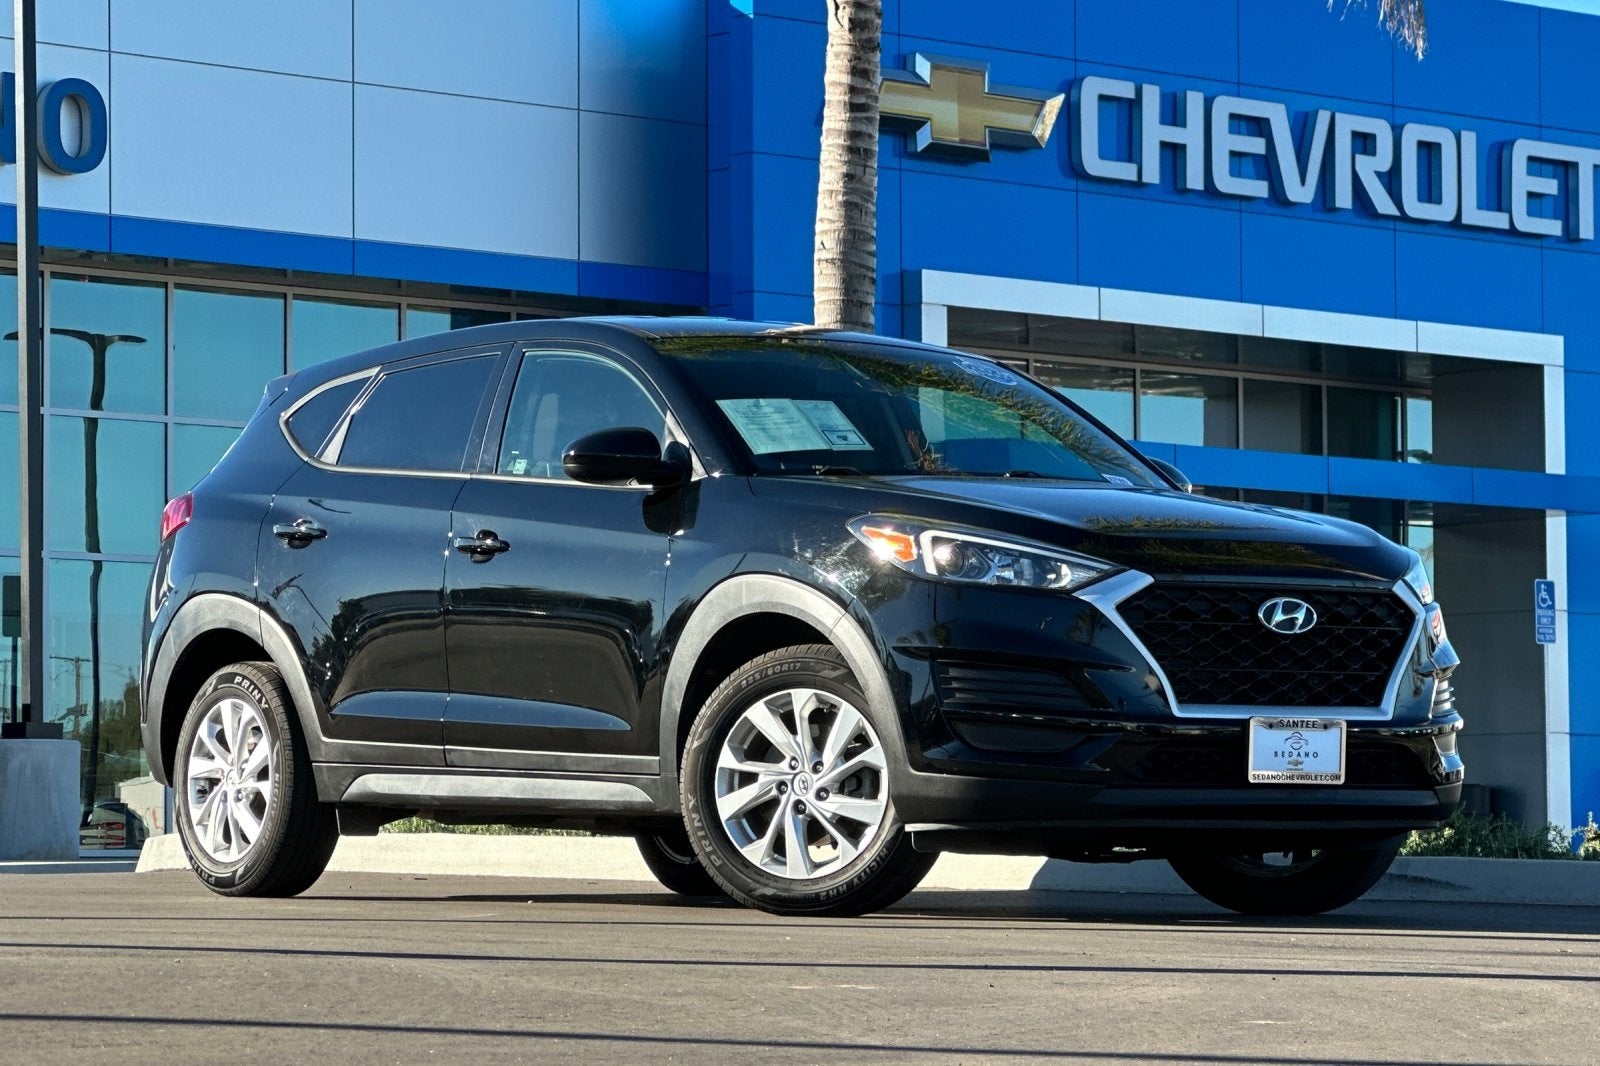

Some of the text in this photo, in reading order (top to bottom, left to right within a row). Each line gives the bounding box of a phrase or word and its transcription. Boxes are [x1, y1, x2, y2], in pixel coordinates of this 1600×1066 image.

[1074, 75, 1600, 240] CHEVROLET
[1279, 719, 1319, 729] SANTEE
[1252, 773, 1341, 782] SEDANOCHEVROLET.COM
